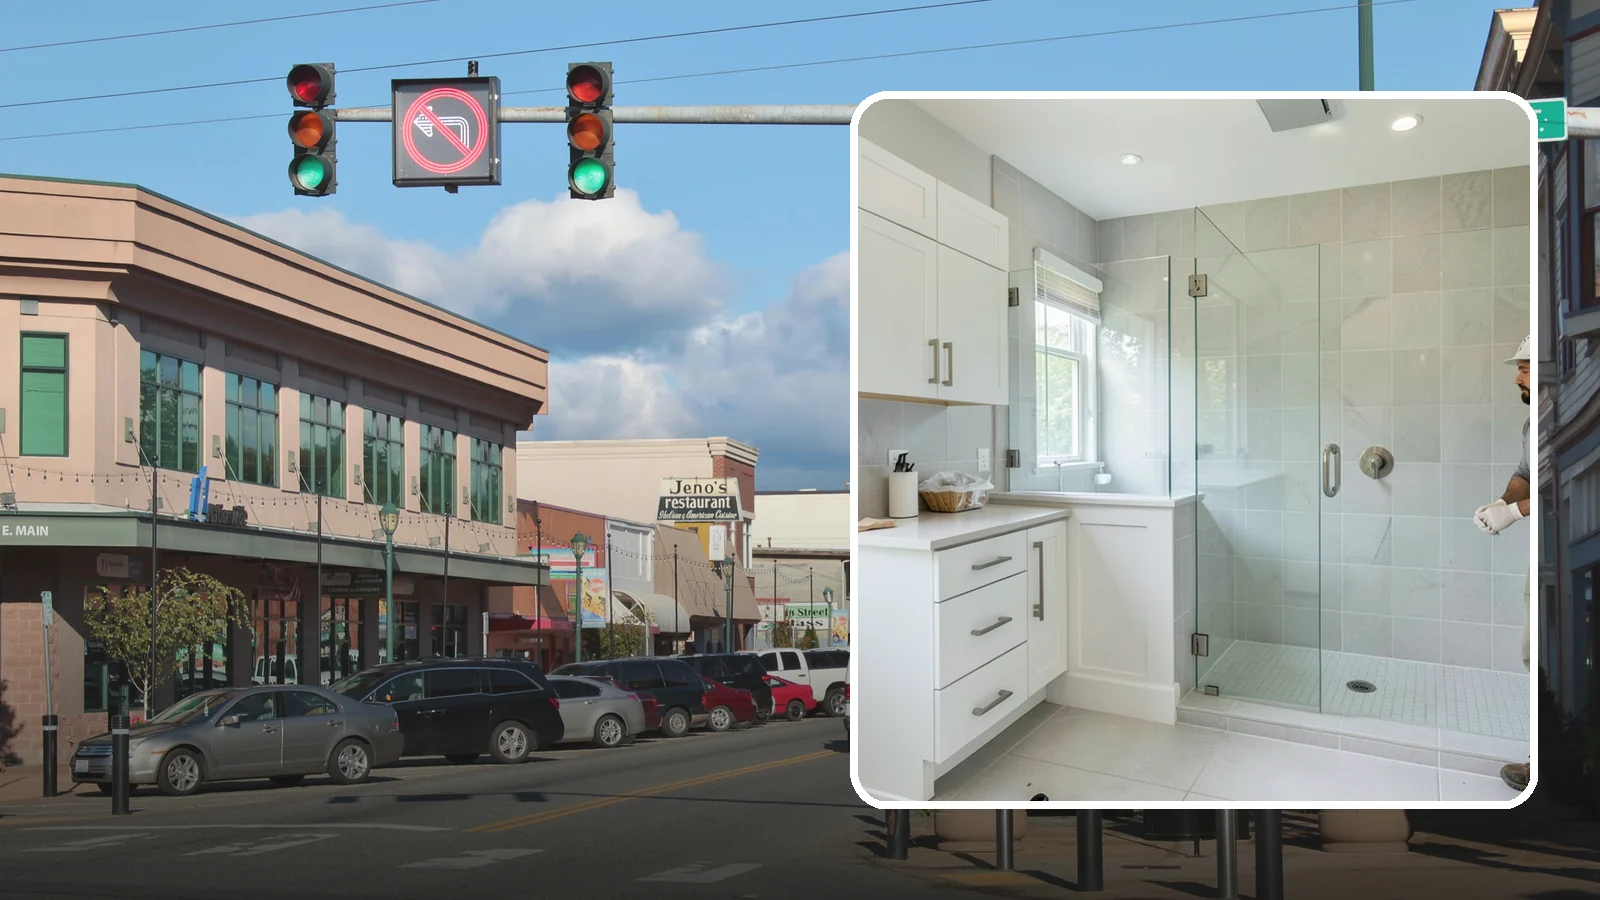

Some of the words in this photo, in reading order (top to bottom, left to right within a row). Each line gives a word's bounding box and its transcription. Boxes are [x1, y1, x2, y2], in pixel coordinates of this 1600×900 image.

[669, 480, 727, 494] Jeno's
[665, 496, 731, 509] restaurant
[658, 510, 681, 519] Italian
[686, 510, 714, 519] American
[715, 509, 737, 519] Cuisine
[2, 525, 13, 536] E.
[15, 525, 49, 536] MAIN
[797, 608, 828, 616] Street
